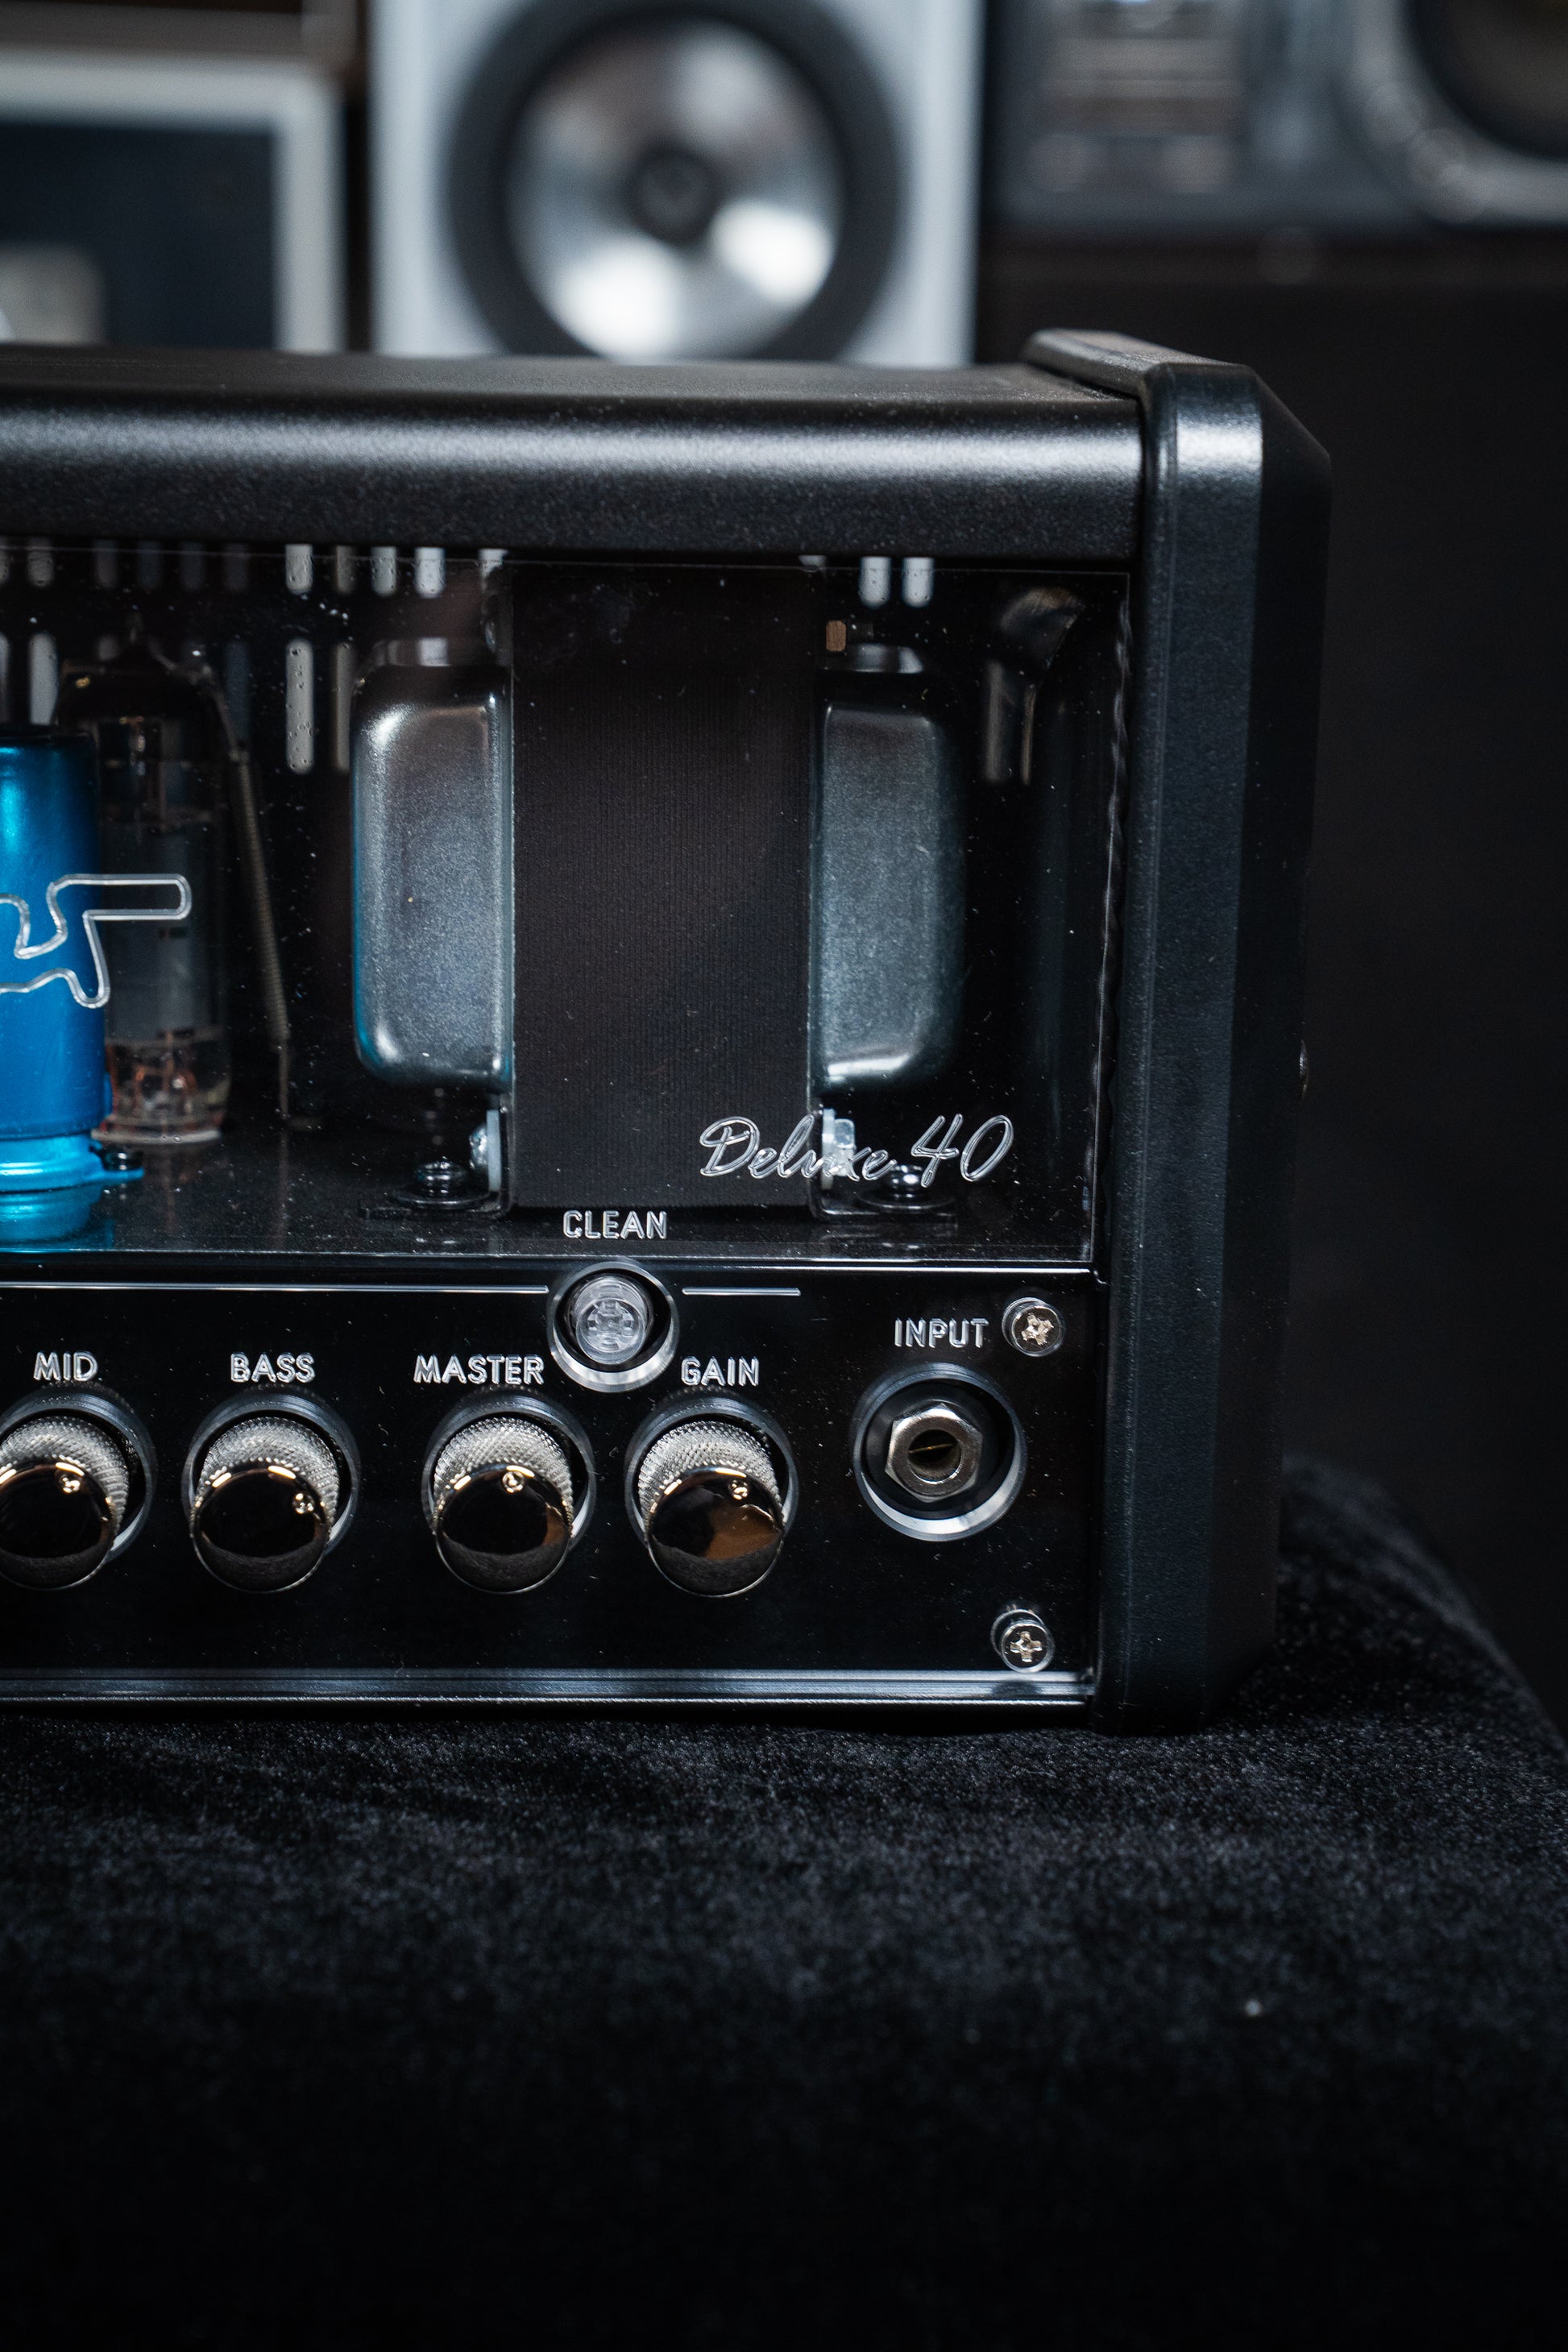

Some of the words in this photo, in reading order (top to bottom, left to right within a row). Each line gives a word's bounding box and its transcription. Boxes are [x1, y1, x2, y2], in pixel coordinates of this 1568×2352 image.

[699, 1115, 898, 1182] Deluxe
[911, 1114, 1014, 1188] 40
[562, 1209, 668, 1240] CLEAN
[894, 1317, 990, 1349] INPUT
[32, 1351, 98, 1383] MID
[230, 1353, 316, 1384] BASS
[413, 1354, 545, 1386] MASTER
[680, 1356, 760, 1388] GAIN
